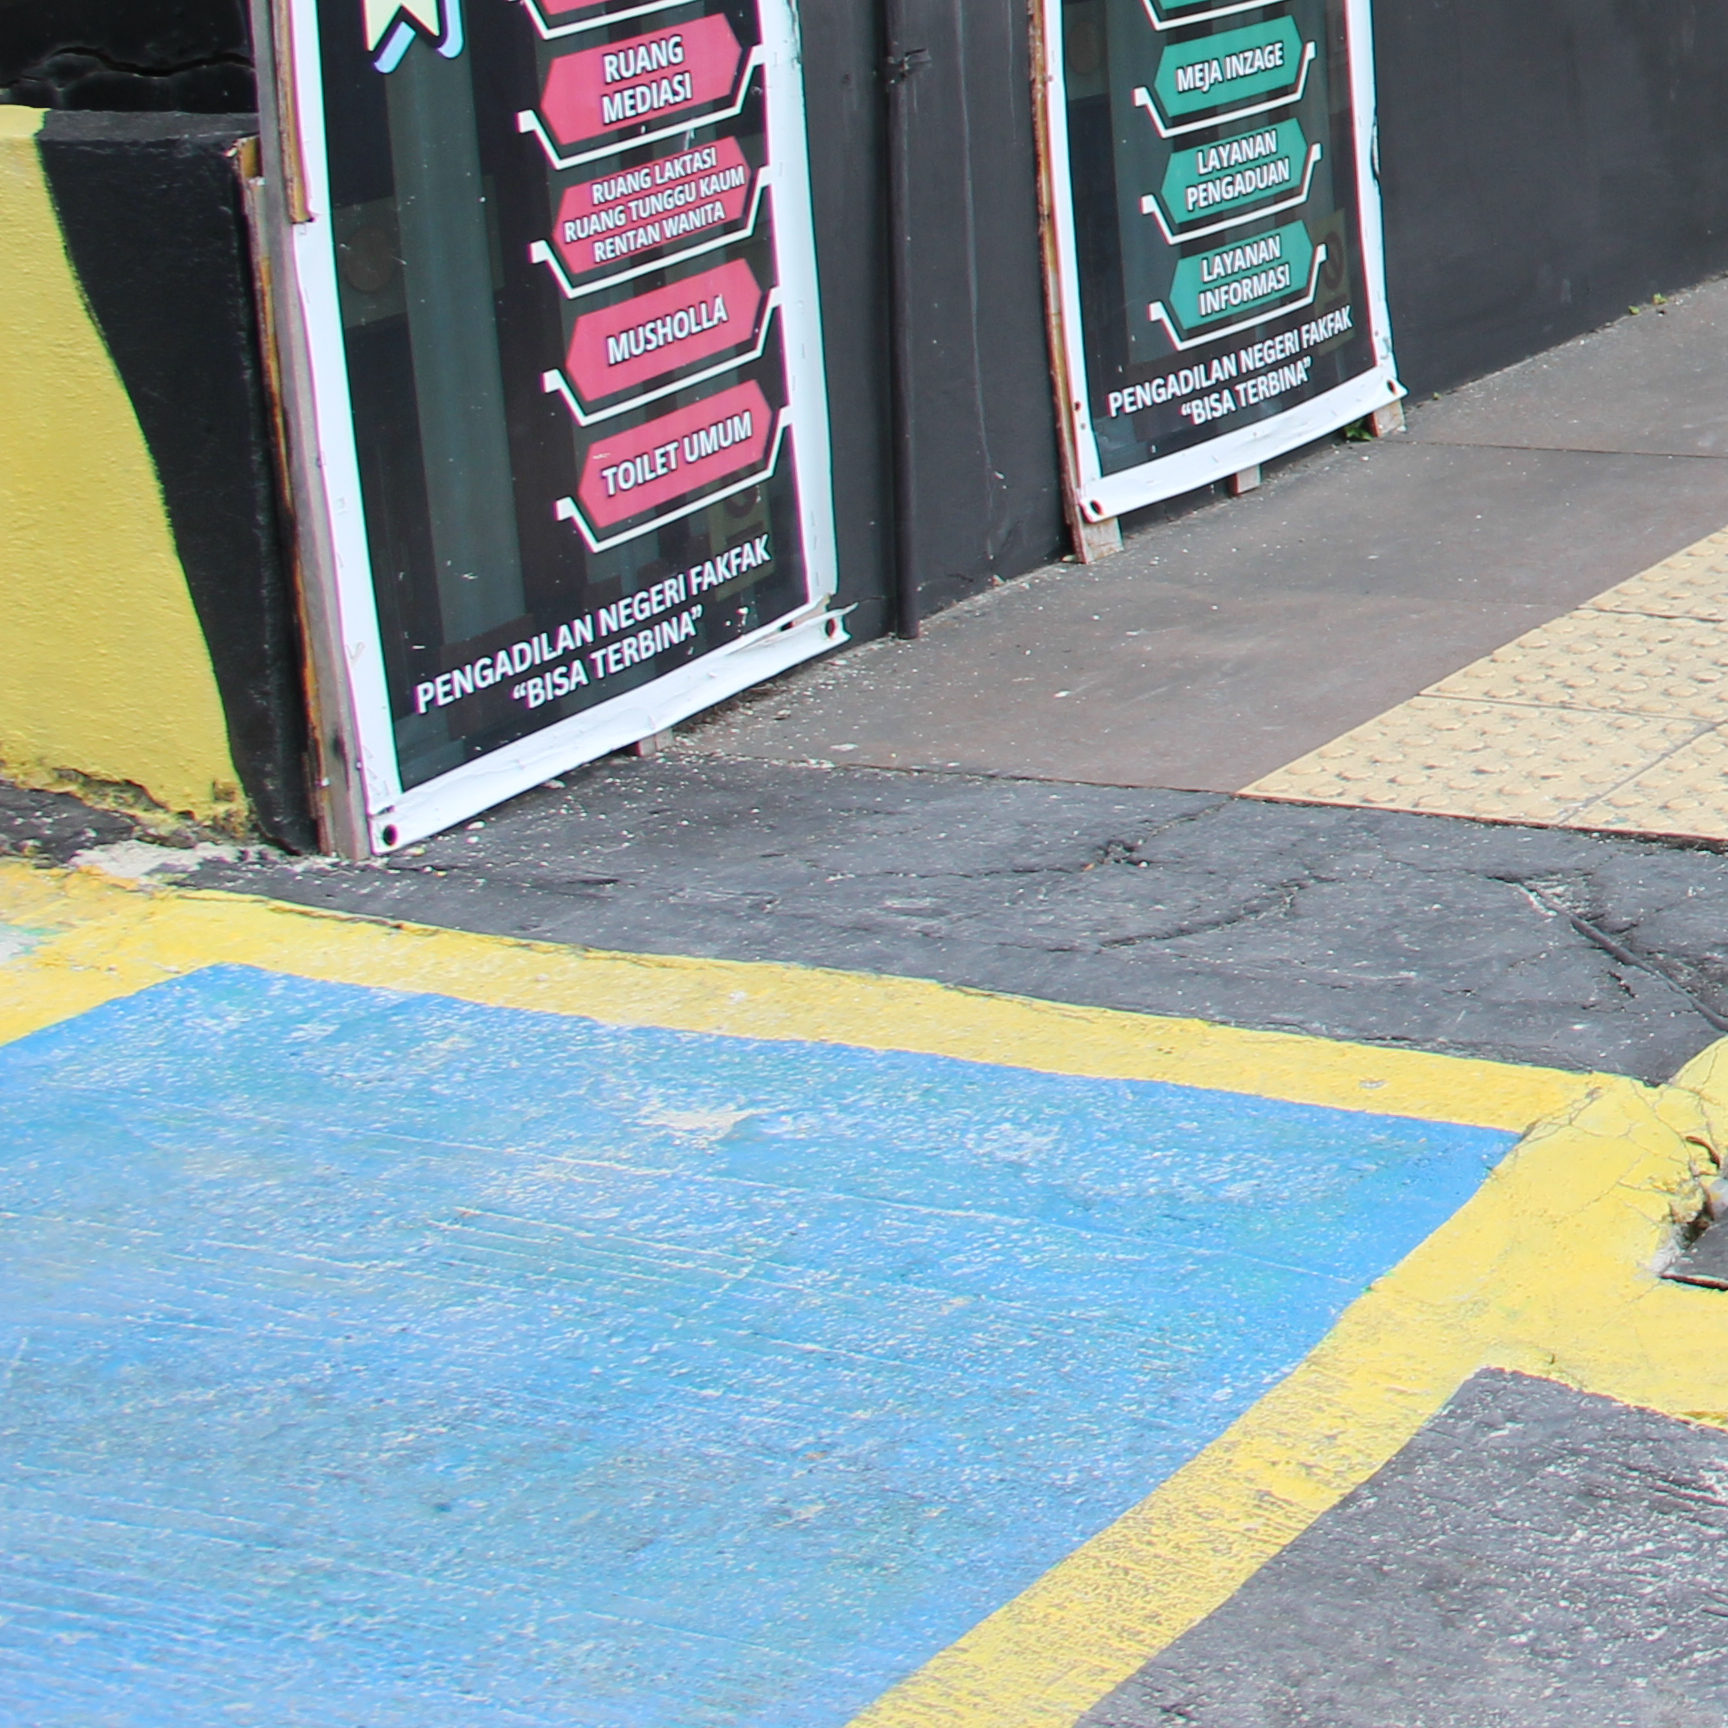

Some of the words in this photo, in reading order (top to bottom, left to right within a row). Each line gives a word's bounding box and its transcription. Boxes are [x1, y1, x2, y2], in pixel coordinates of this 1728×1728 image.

[604, 35, 684, 83] RUANG
[1176, 59, 1223, 93] MEJA
[1225, 42, 1284, 80] INZAGE
[601, 72, 693, 124] MEDIASI
[591, 167, 652, 205] RUANG
[655, 146, 717, 185] LAKTASI
[1197, 130, 1277, 175] LAYANAN
[563, 205, 626, 244] RUANG
[628, 183, 697, 224] TUNGGU
[699, 166, 745, 198] KAUM
[1186, 158, 1290, 212] PENGADUAN
[593, 226, 661, 263] RENTAN
[664, 201, 726, 240] WANITA
[1202, 235, 1281, 283] LAYANAN
[1199, 263, 1291, 316] INFORMASI
[607, 294, 728, 366] MUSHOLLA
[1108, 354, 1237, 418] PENGADILAN
[1239, 328, 1300, 373] NEGERI
[1301, 305, 1353, 347] FAKFAK
[602, 441, 679, 497] TOILET
[684, 411, 753, 465] UMUM
[414, 612, 594, 715] PENGADILAN
[598, 572, 687, 638] NEGERI
[690, 533, 771, 597] FAKFAK
